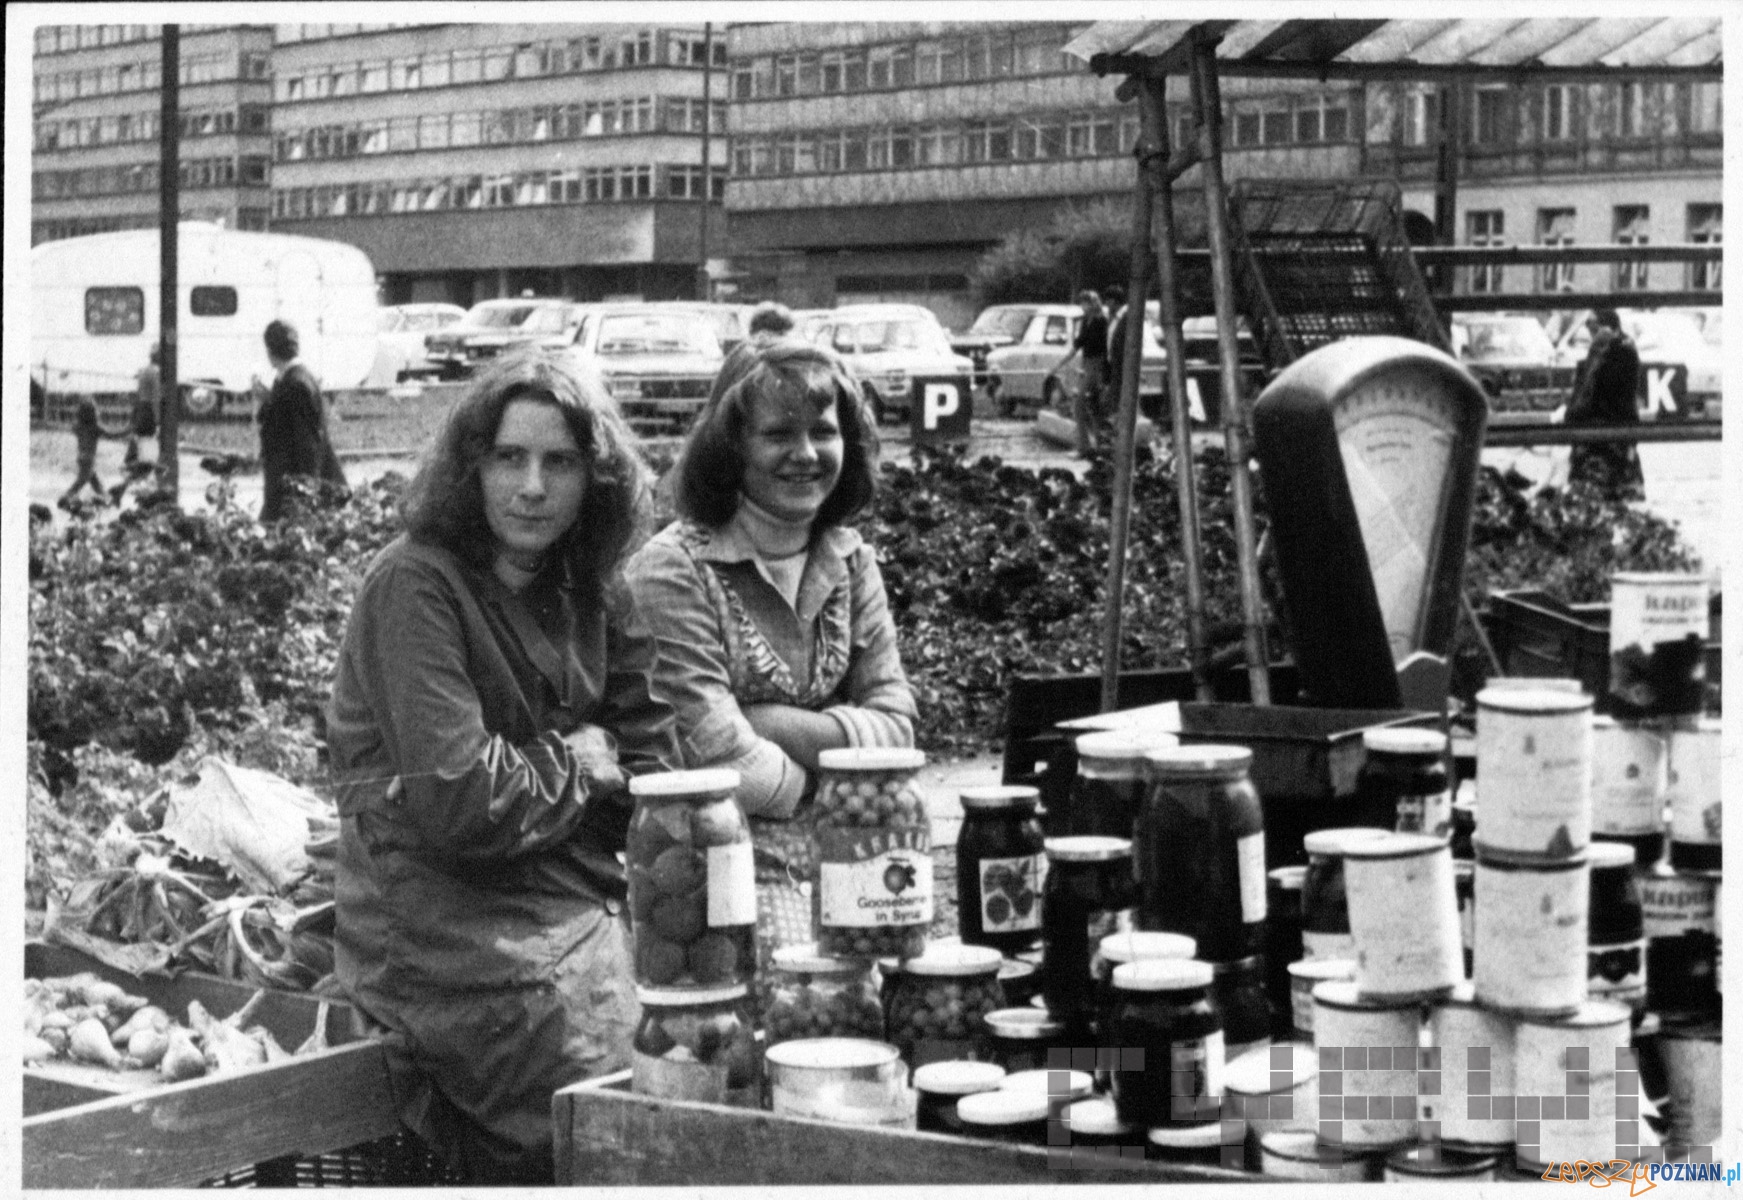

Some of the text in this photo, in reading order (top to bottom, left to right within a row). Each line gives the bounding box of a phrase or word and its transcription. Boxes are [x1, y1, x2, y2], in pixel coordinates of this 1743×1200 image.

[924, 383, 959, 430] P
[1647, 367, 1677, 412] K
[876, 912, 887, 921] in
